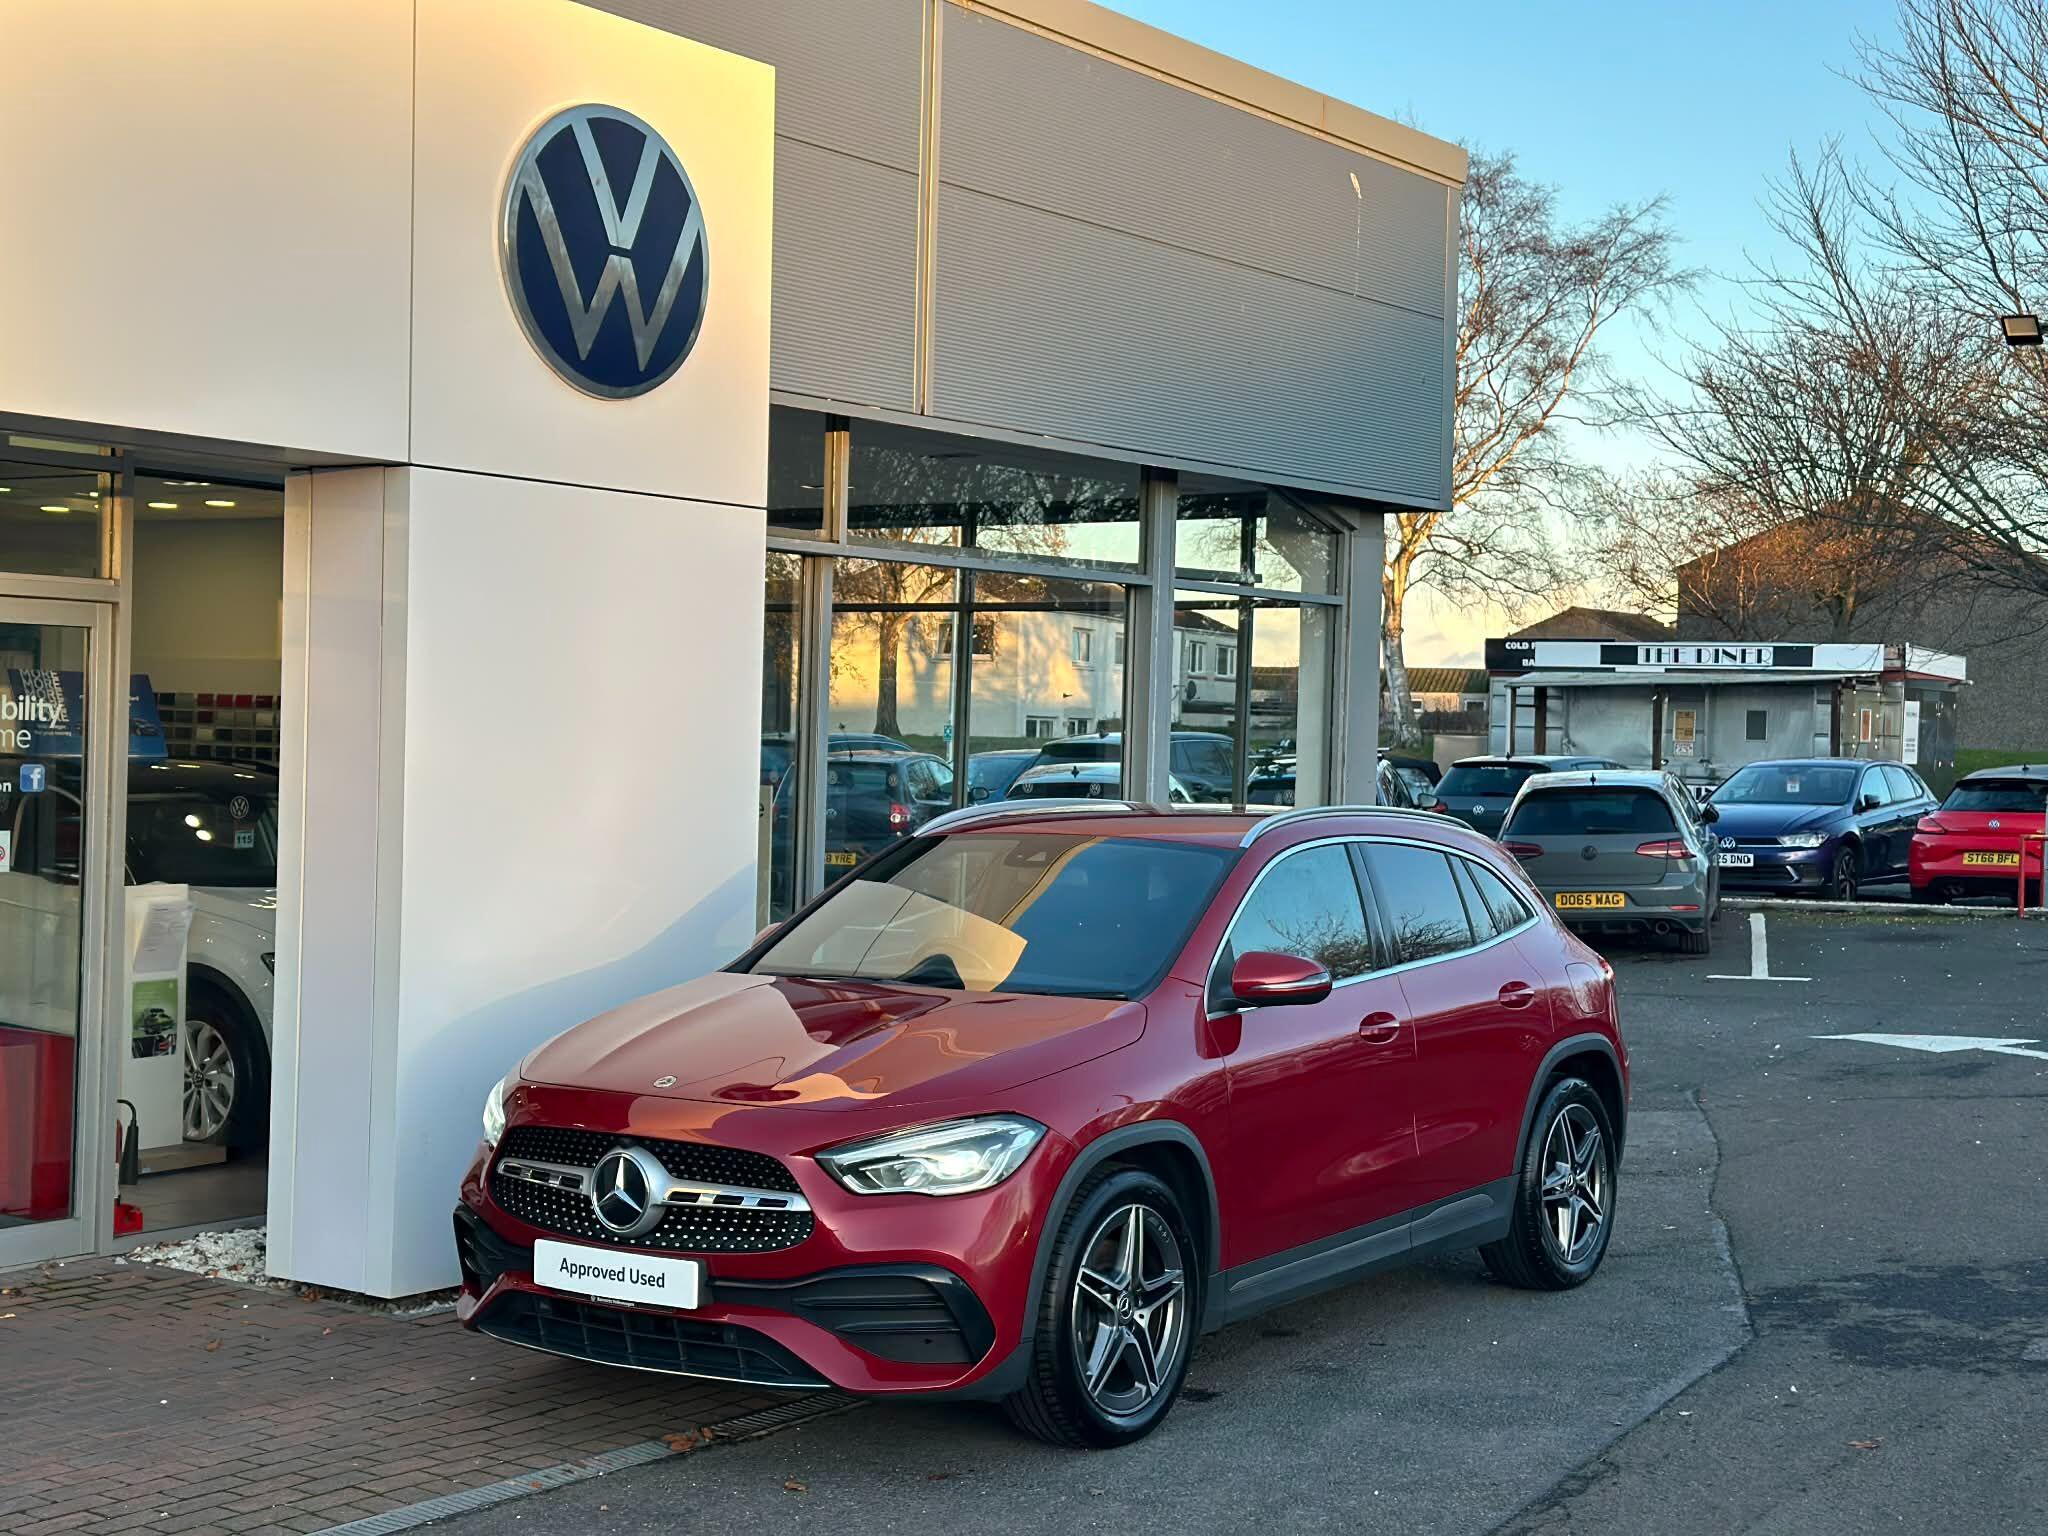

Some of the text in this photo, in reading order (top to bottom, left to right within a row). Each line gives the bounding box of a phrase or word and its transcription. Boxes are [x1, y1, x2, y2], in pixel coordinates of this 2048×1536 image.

[1505, 641, 1529, 650] COLD
[1640, 646, 1772, 665] THE DINER
[1967, 853, 1995, 863] ST66
[1560, 894, 1592, 906] DO65
[560, 1257, 665, 1289] Approved Used
